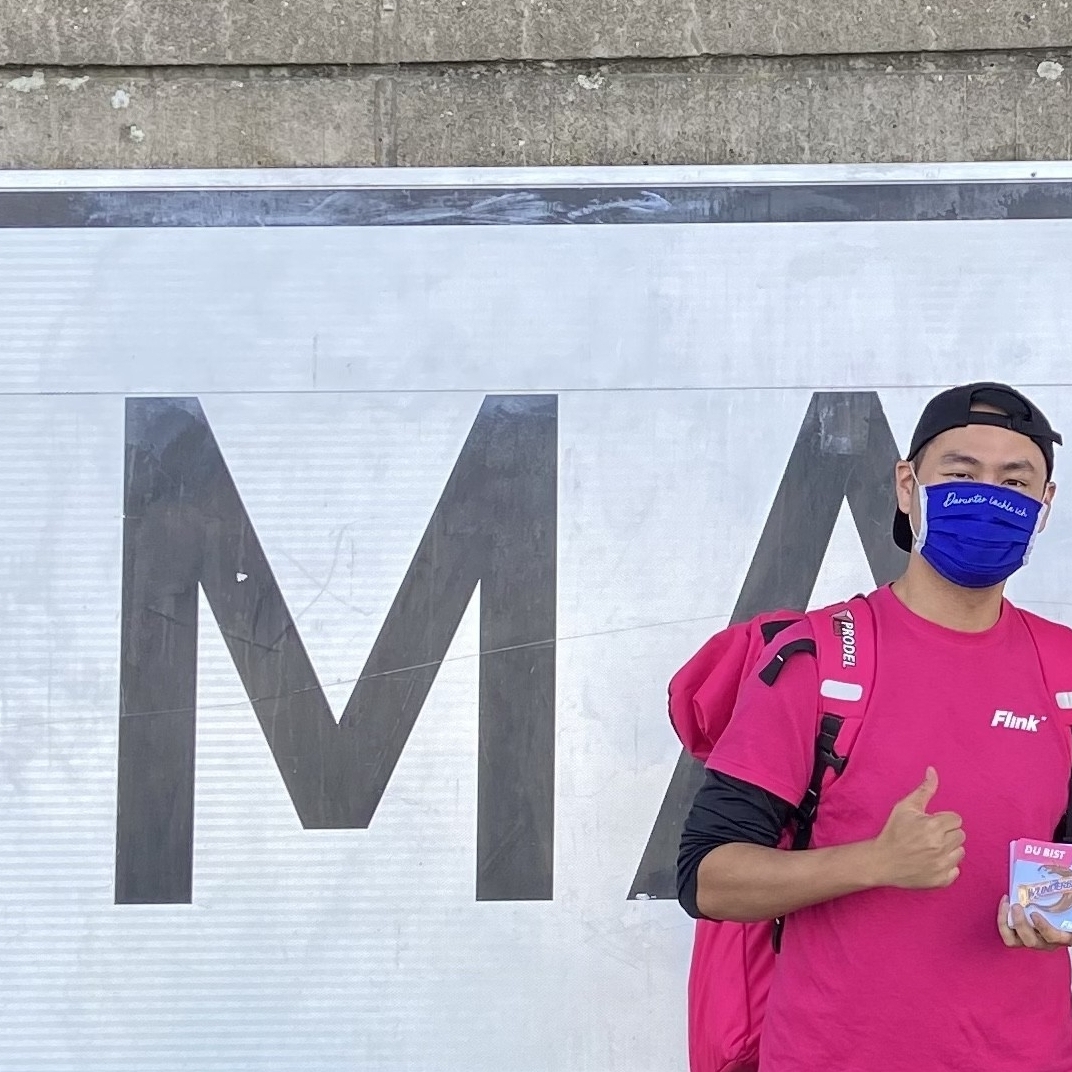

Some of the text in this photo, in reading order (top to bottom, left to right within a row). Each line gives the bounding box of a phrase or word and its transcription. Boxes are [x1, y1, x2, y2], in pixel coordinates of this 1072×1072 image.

[841, 621, 856, 668] PRODEL
[990, 709, 1041, 732] Flink
[1024, 844, 1066, 860] DU BIST
